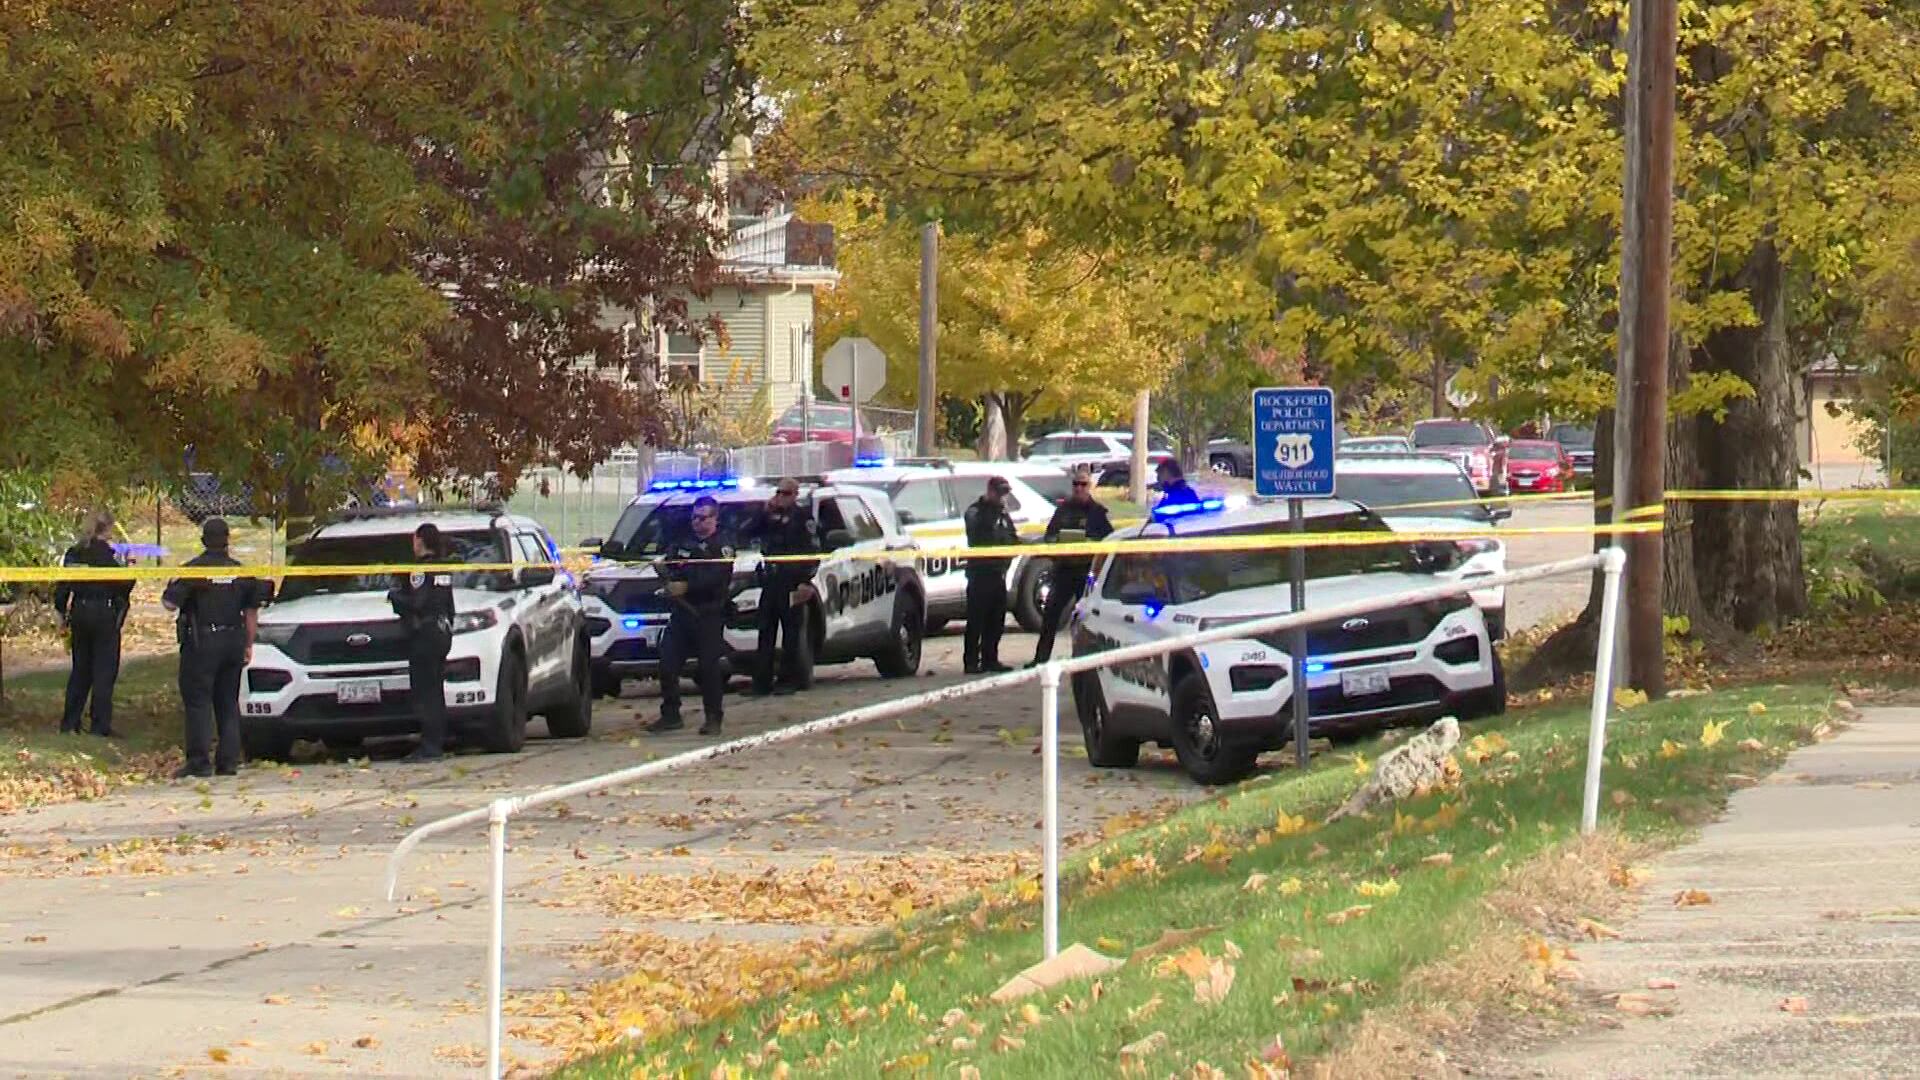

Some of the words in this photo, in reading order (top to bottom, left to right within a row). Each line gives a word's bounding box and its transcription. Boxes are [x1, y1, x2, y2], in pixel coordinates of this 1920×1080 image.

[1260, 395, 1328, 406] ROCKFORD
[1272, 407, 1314, 418] POLICE
[1261, 420, 1325, 431] DEPARTMENT
[1280, 444, 1308, 461] 911
[1274, 481, 1317, 491] WATCH
[455, 690, 485, 703] 239
[246, 702, 271, 714] 239
